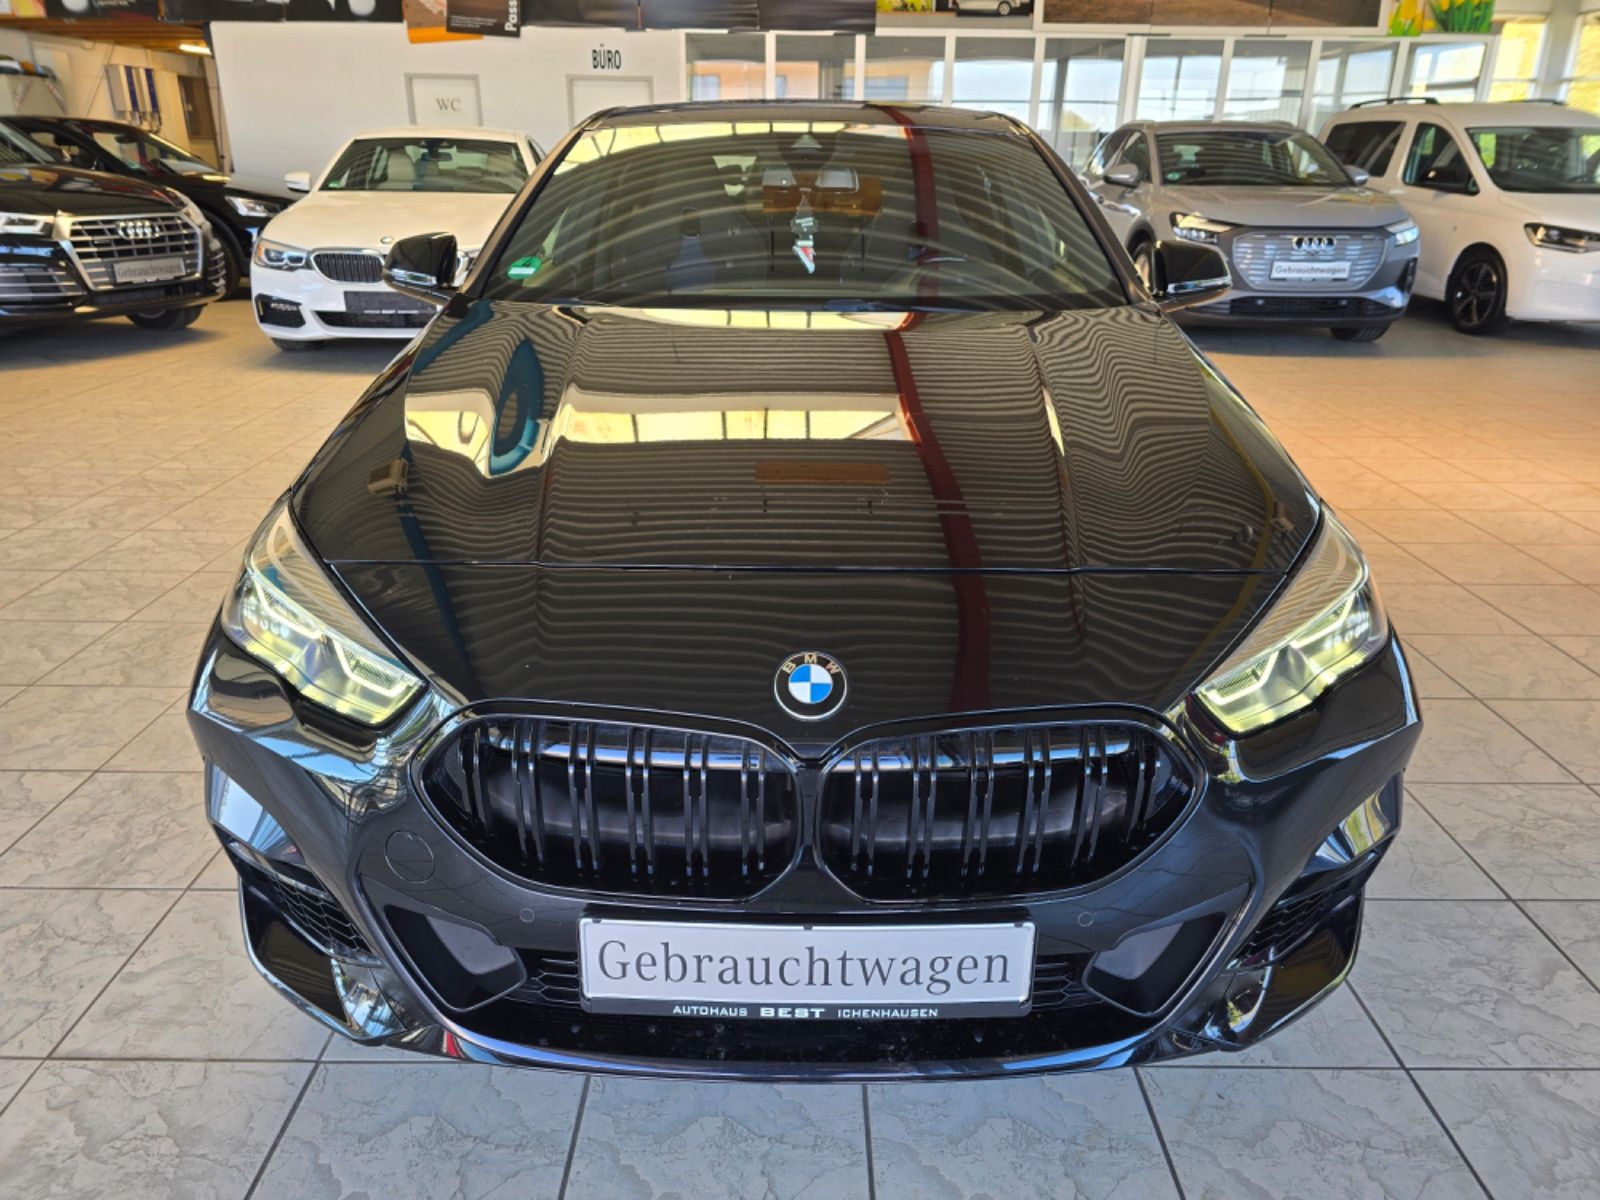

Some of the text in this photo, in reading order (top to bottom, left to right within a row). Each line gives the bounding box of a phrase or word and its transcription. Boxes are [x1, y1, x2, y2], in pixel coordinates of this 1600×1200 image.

[592, 43, 621, 69] BÜRO
[436, 98, 461, 112] WC
[1275, 264, 1346, 275] Gebrauchtwagen
[782, 652, 842, 675] BMW
[598, 940, 1009, 995] Gebrauchtwagen
[672, 1005, 939, 1018] AUTOHAUS BEST ICHENHAUSEN
